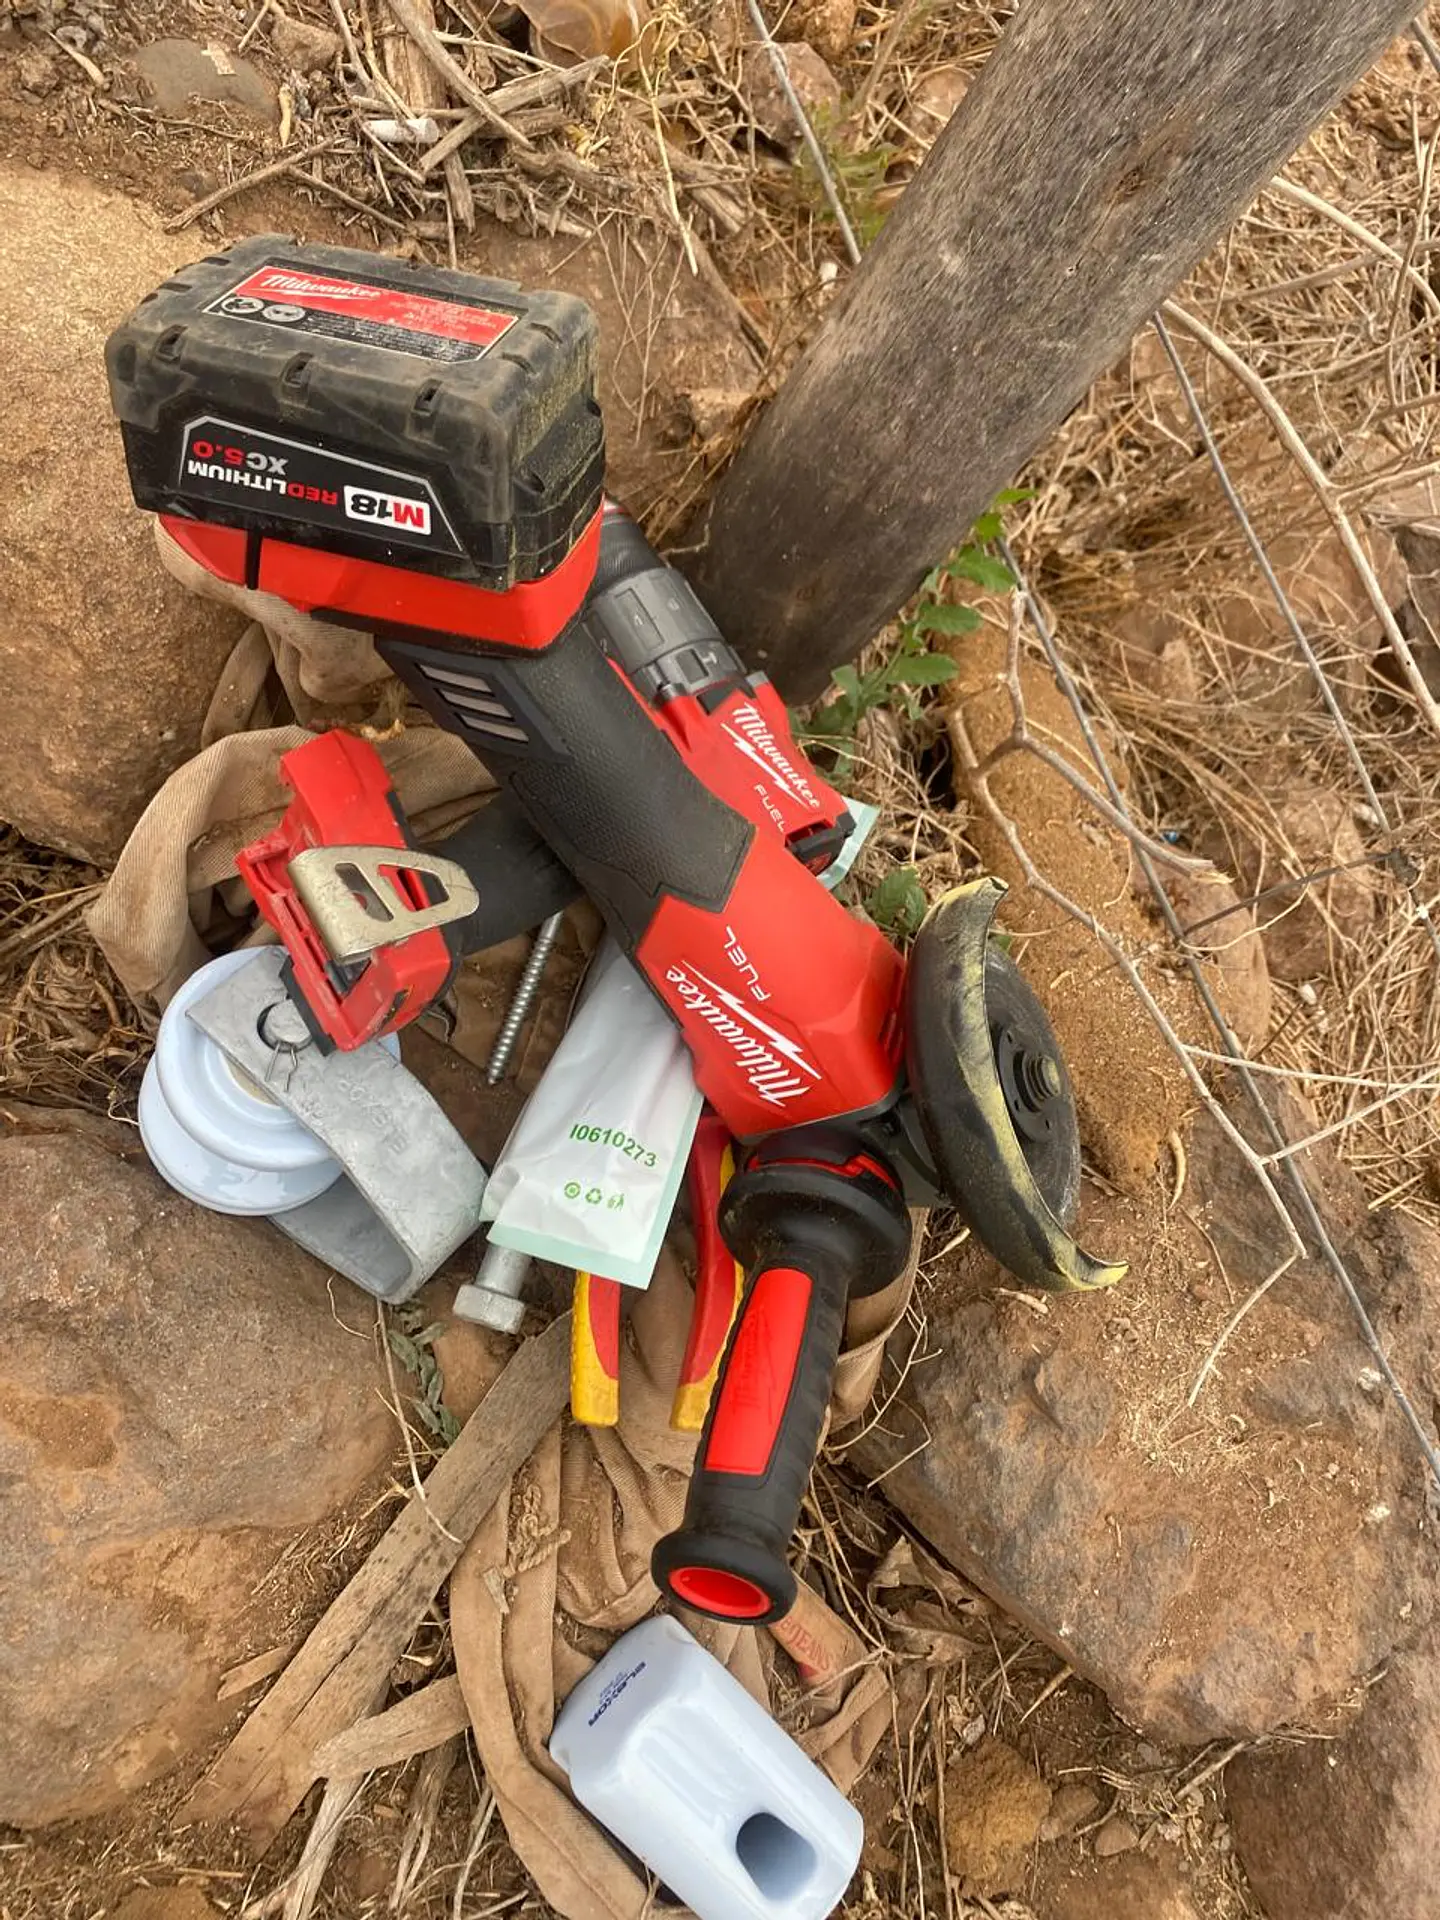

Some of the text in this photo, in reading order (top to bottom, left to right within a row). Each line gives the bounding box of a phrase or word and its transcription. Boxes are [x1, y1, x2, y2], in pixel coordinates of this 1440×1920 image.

[259, 273, 381, 299] Milwaukee
[193, 440, 288, 475] XC5.0
[188, 460, 425, 528] M18 REDLITHIUM
[732, 702, 821, 808] Milwaukee
[753, 784, 786, 832] FUEL
[723, 925, 772, 1002] FUEL
[666, 965, 812, 1108] Milwaukee
